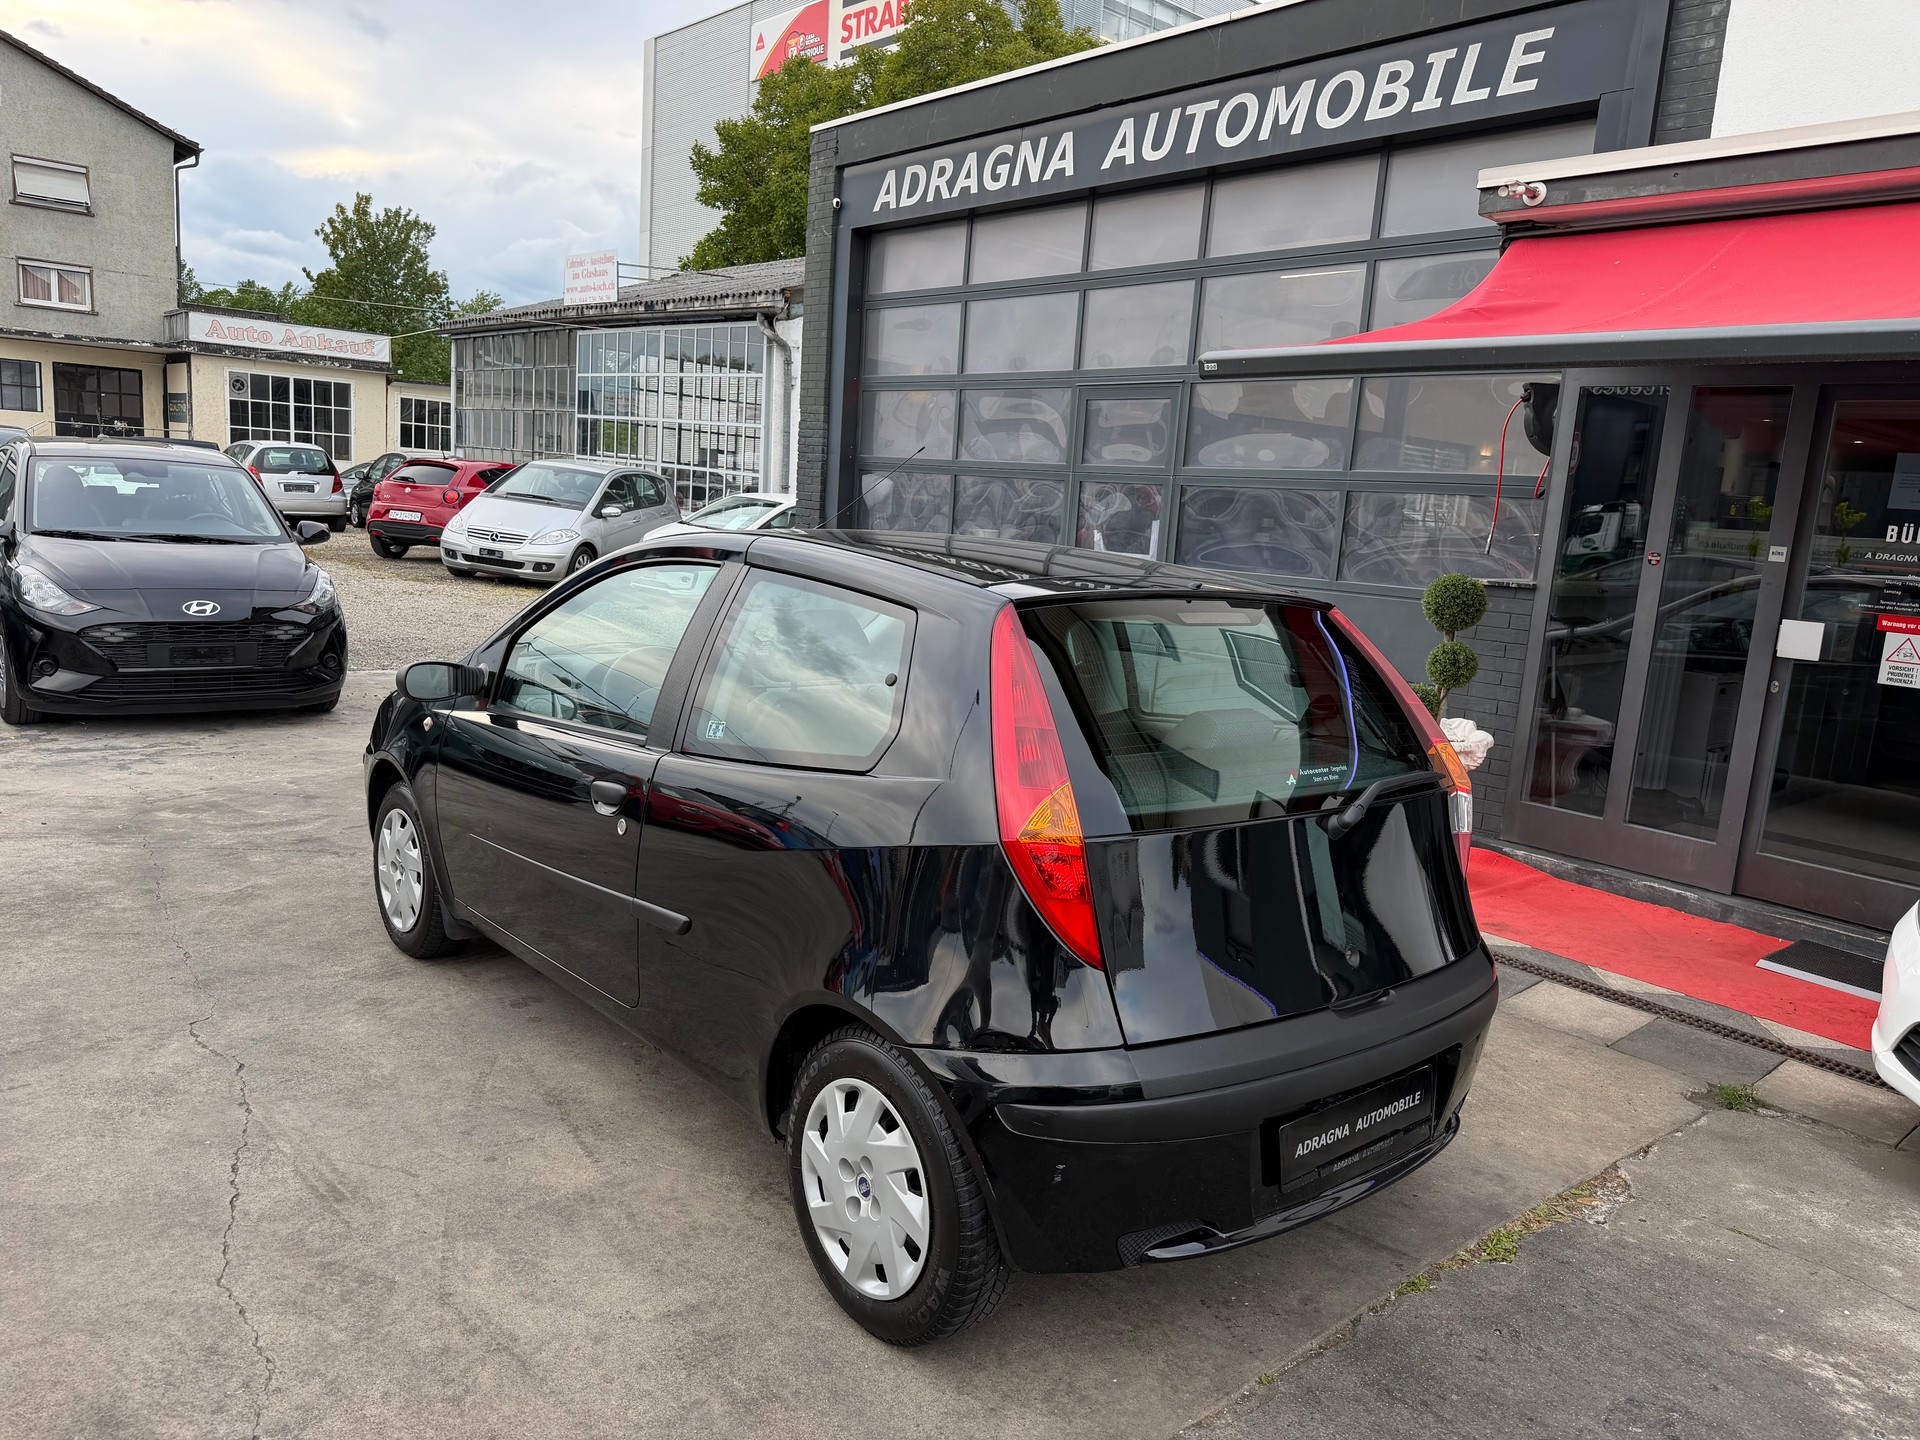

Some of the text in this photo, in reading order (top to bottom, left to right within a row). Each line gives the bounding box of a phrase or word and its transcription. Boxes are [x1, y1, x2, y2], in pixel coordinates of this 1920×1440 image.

[872, 26, 1556, 212] ADRAGNA AUTOMOBILE
[572, 267, 609, 280] im Glashaus
[566, 279, 616, 293] www.auto-koch.ch
[205, 319, 376, 356] Auto Ankauf
[1885, 523, 1920, 545] BÜ
[1882, 620, 1906, 629] Warnung
[1887, 671, 1914, 679] PRUDENCE
[1888, 665, 1915, 673] VORSICHT
[1886, 677, 1913, 685] PRUDENZA
[1299, 767, 1329, 776] Autocenter
[1294, 1091, 1422, 1158] ADRAGNA AUTOMOBILE
